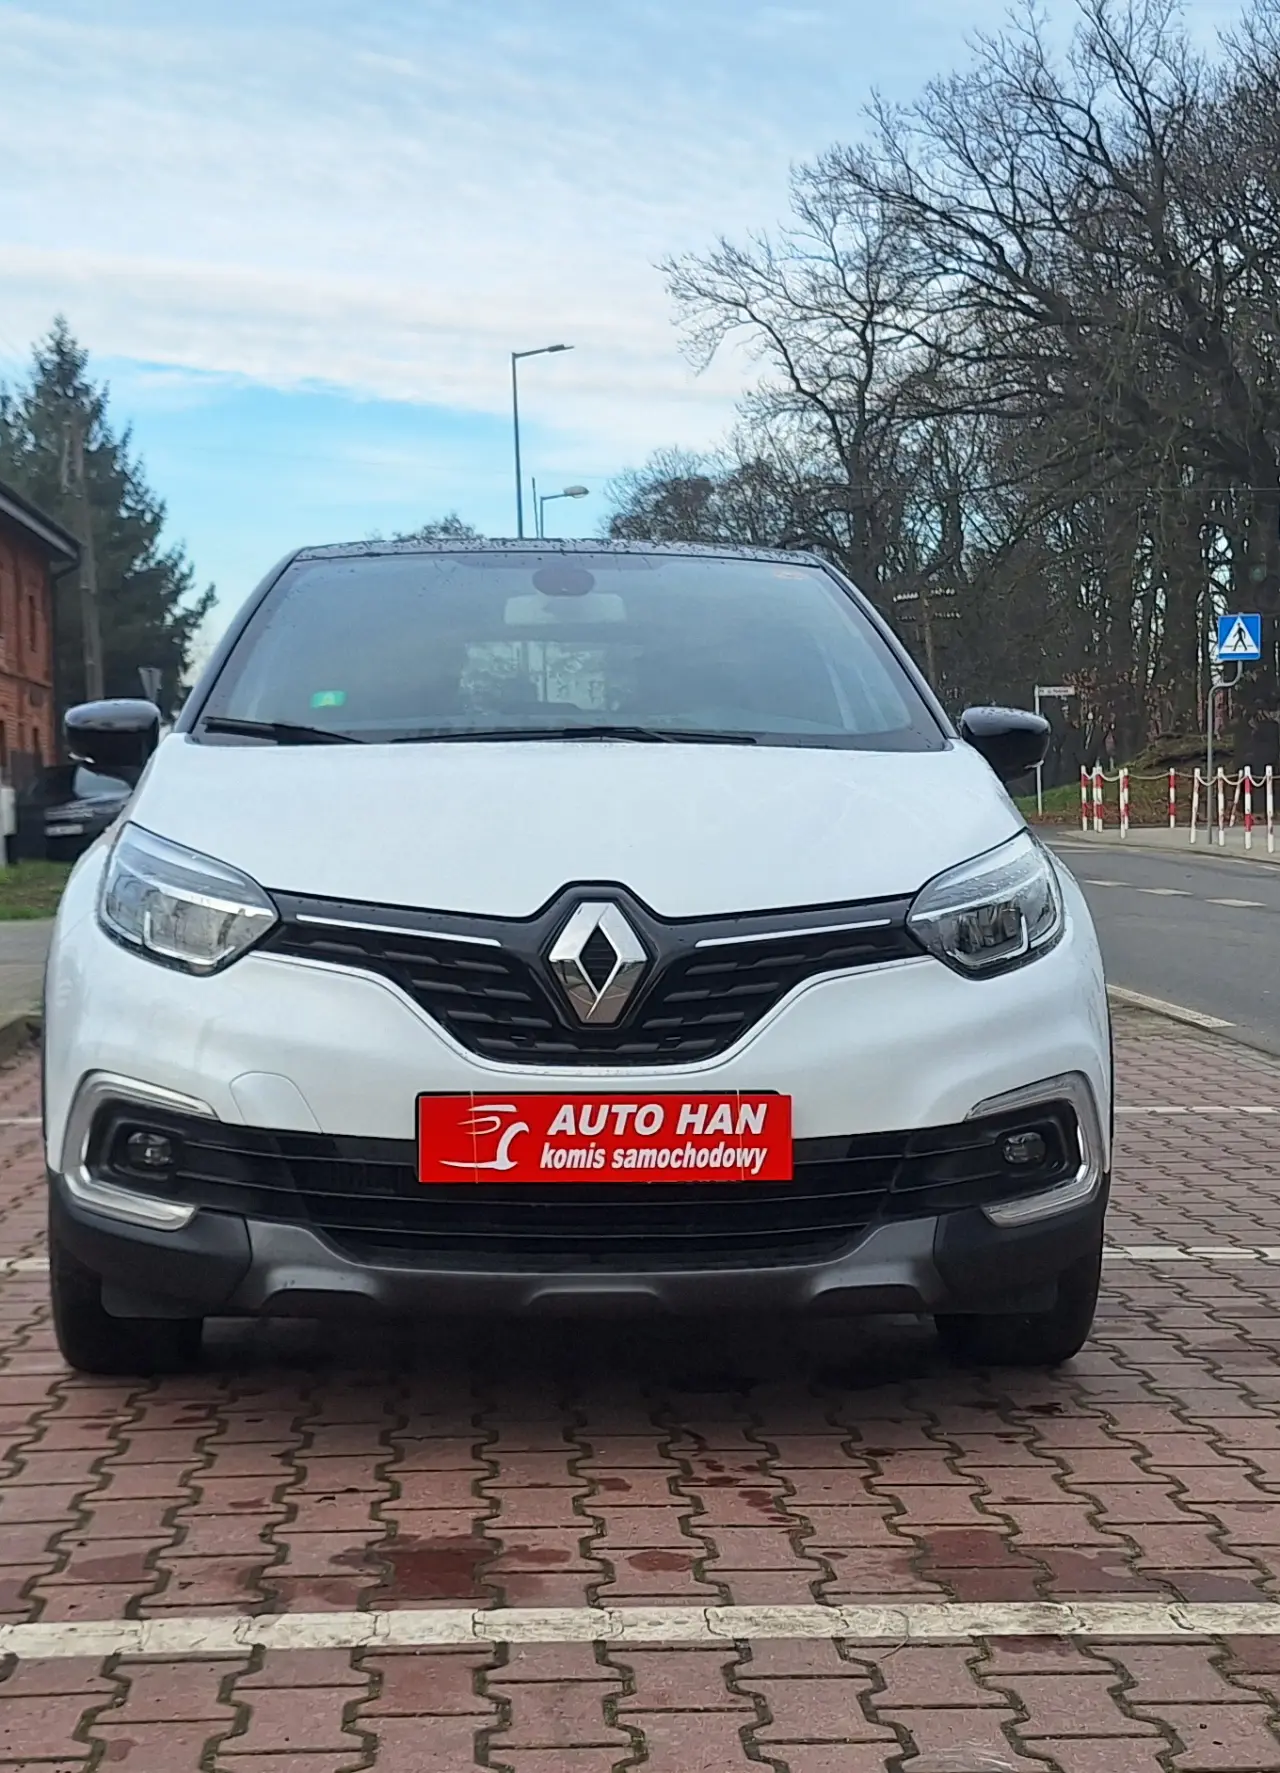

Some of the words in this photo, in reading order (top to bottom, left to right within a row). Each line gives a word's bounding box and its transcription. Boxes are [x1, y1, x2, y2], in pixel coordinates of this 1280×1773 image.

[547, 1103, 666, 1137] AUTO
[675, 1102, 768, 1136] HAN
[539, 1141, 606, 1169] komis
[611, 1140, 768, 1175] samochodowy
